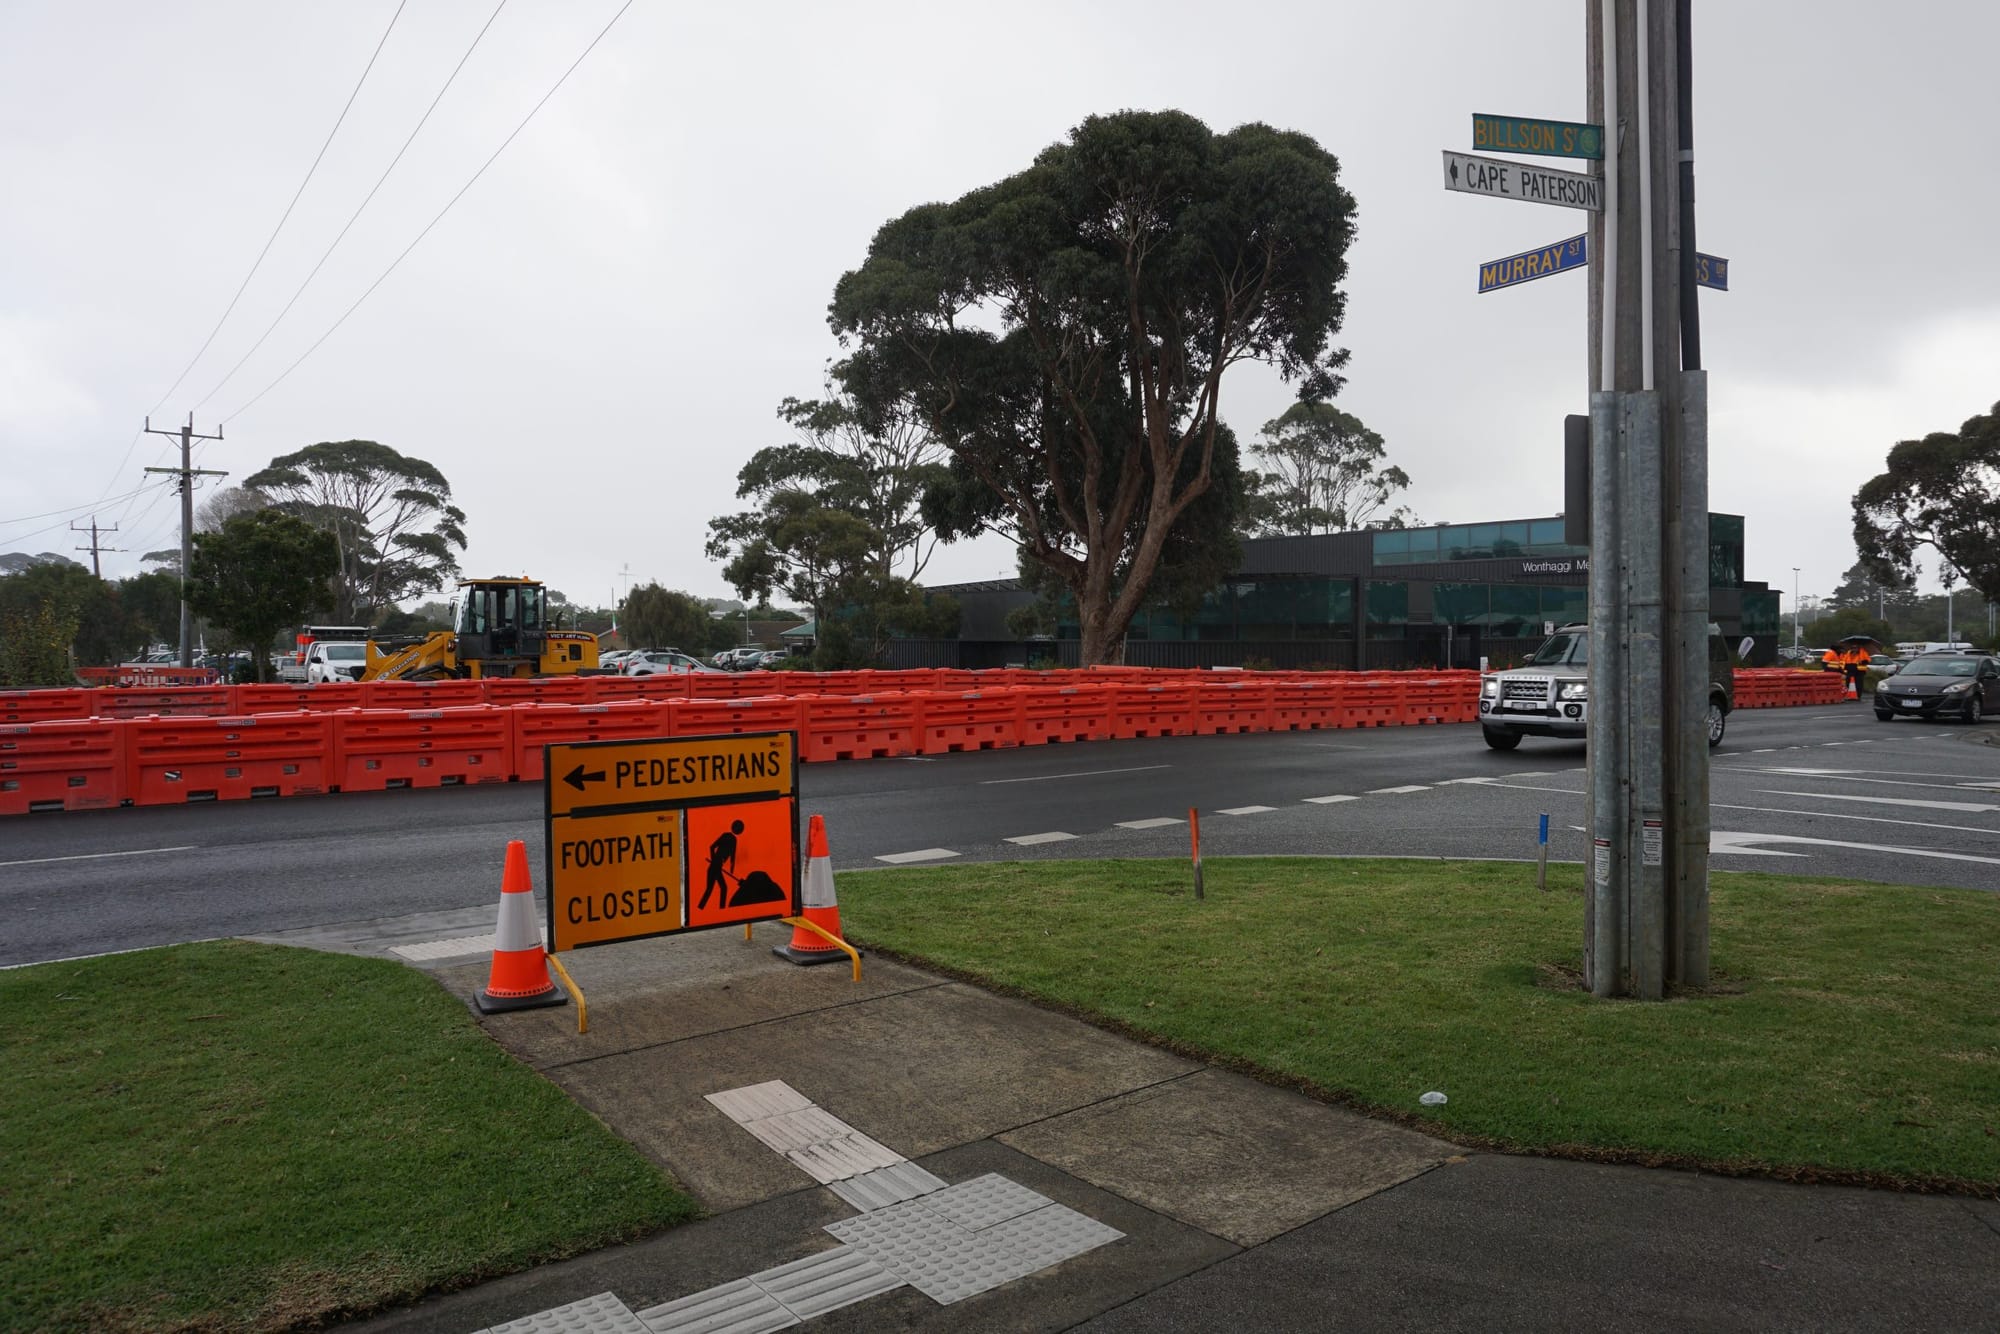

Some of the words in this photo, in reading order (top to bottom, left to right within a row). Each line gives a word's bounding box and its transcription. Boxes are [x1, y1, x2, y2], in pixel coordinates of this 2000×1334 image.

[1475, 119, 1555, 152] BILLSON
[1466, 162, 1510, 194] CAPE
[1521, 171, 1597, 207] PATERSON
[1481, 245, 1565, 289] MURRAY
[1568, 239, 1581, 255] ST
[1522, 560, 1572, 573] Wonthaggi
[615, 750, 780, 789] PEDESTRIANS
[561, 831, 673, 869] FOOTPATH
[567, 886, 669, 924] CLOSED
